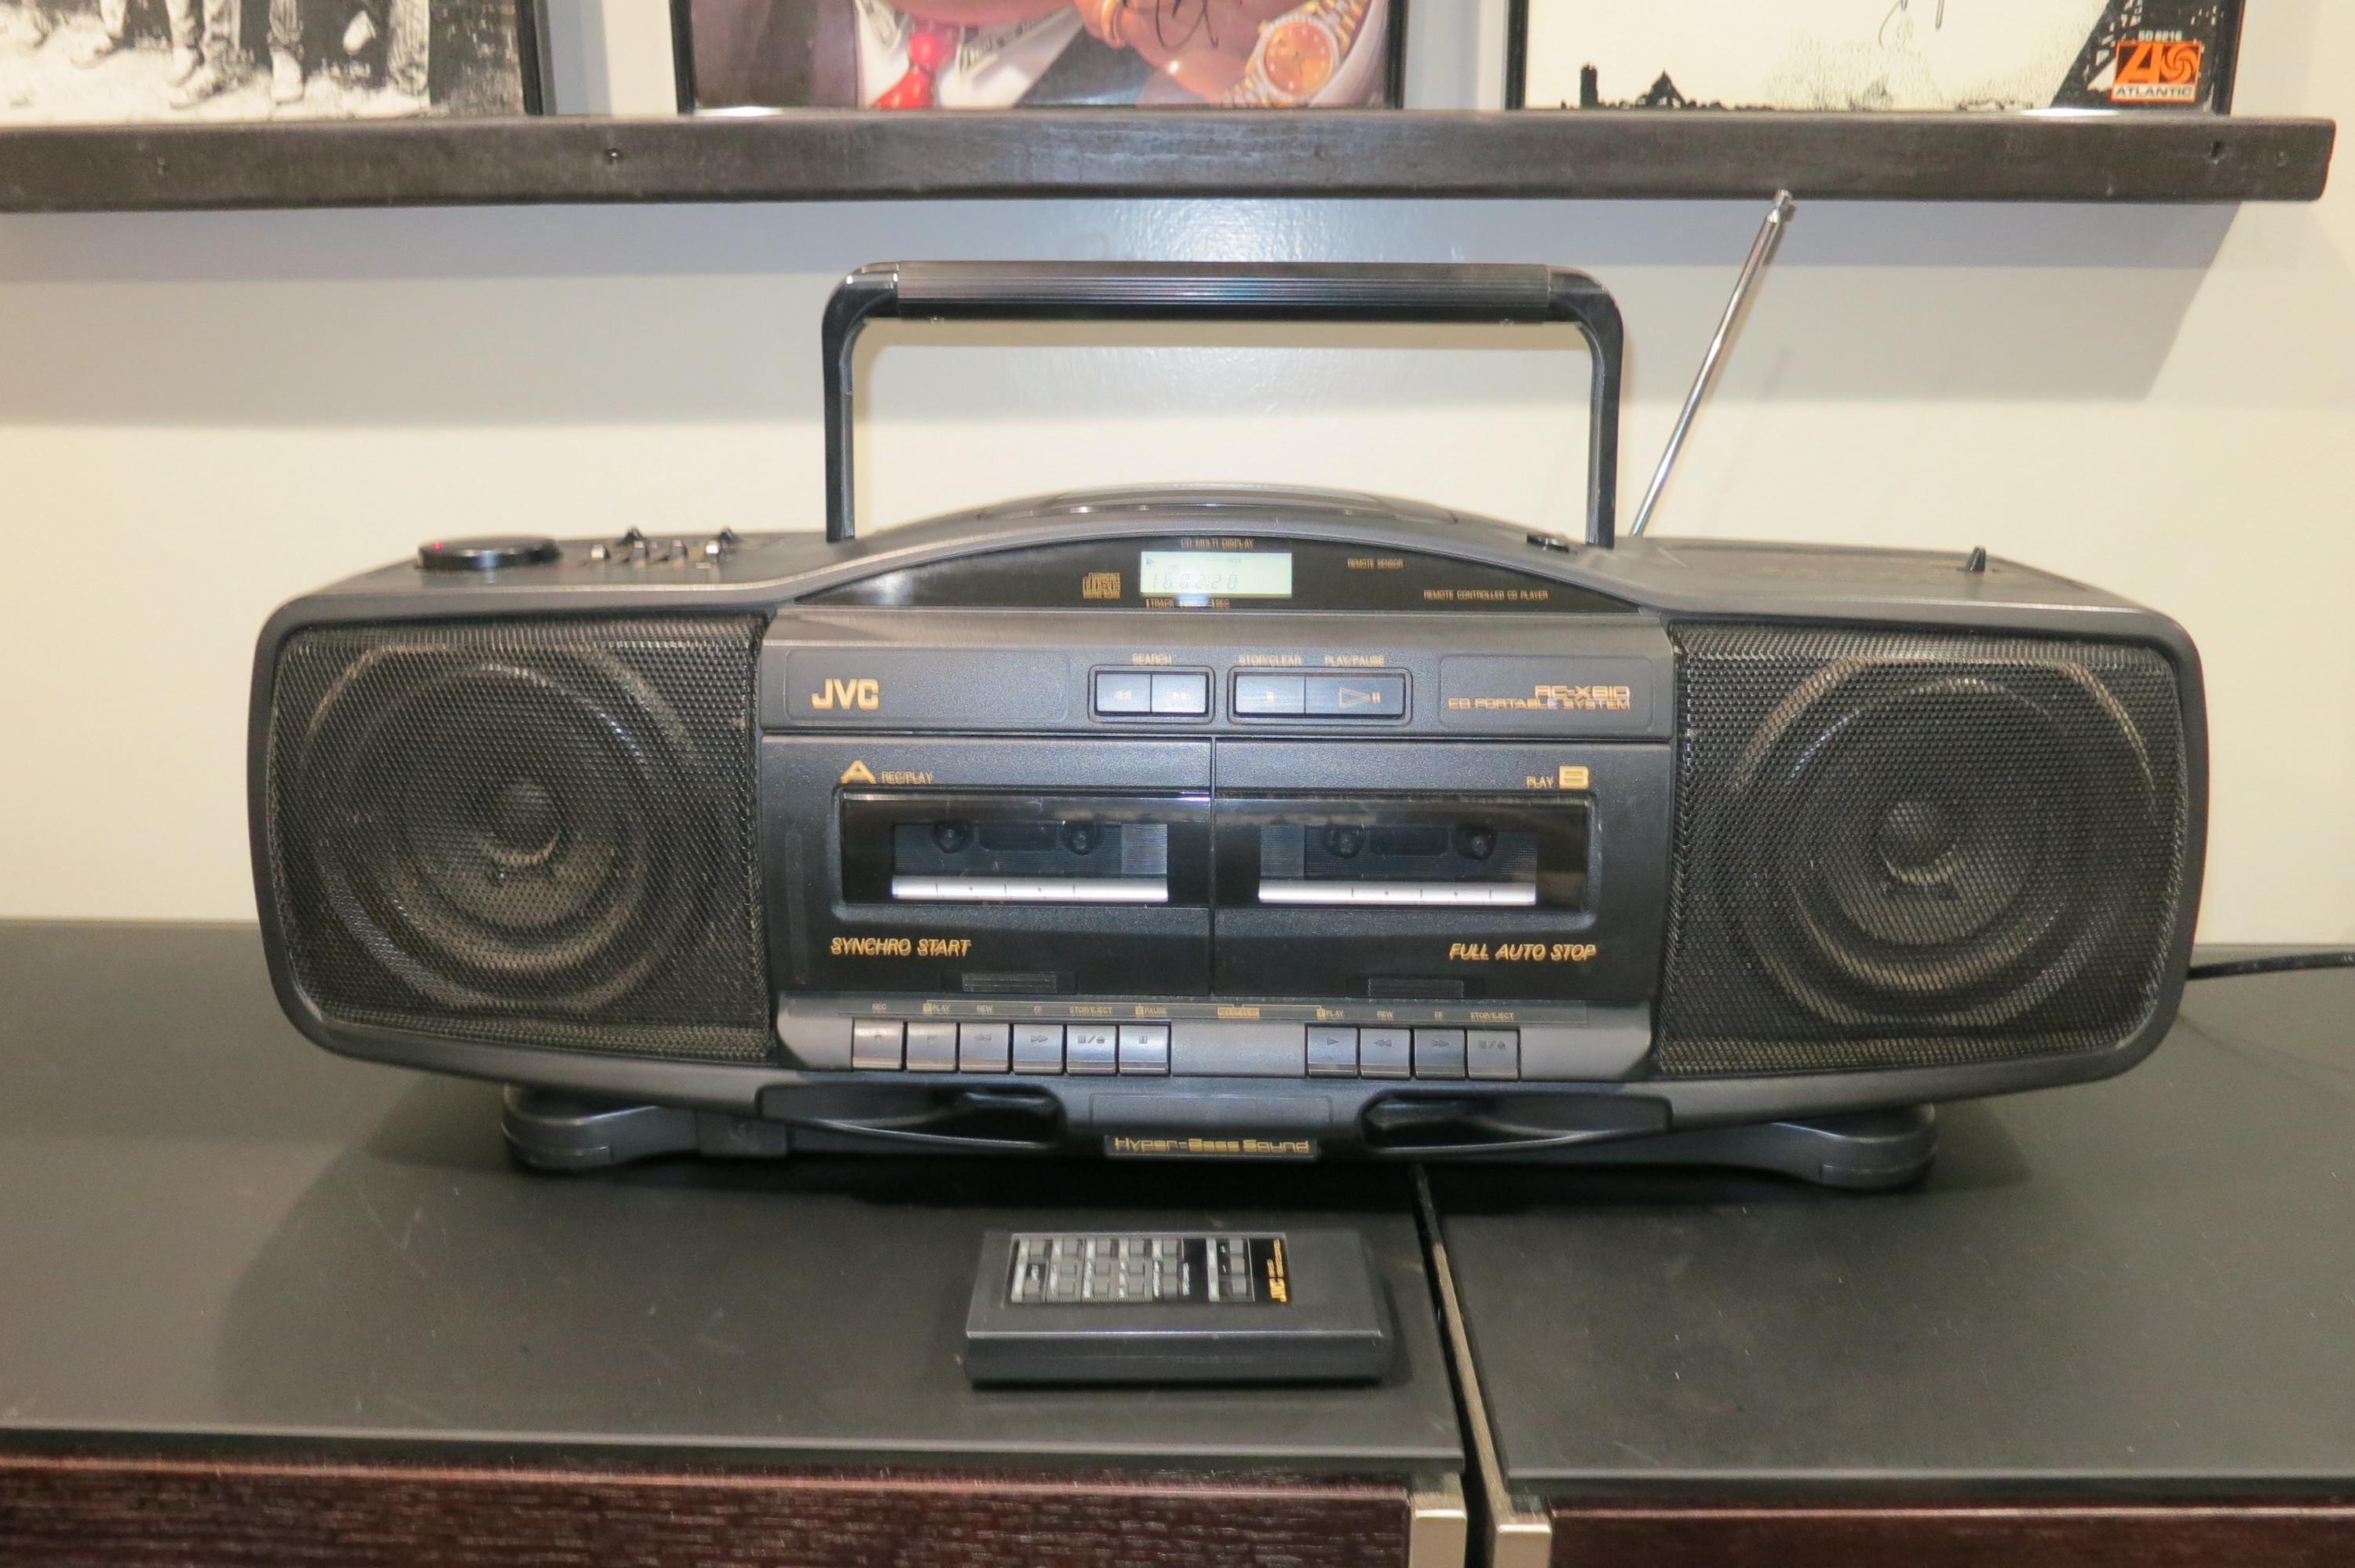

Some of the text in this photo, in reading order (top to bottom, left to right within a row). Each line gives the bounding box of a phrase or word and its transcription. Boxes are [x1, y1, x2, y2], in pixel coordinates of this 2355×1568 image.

[2115, 86, 2193, 97] ATLANTIC
[1347, 558, 1374, 569] REMOTE
[1423, 590, 1549, 600] REMOTE CONTROLLED CD PLAYER
[1132, 653, 1172, 665] SEARCH
[812, 678, 879, 709] JVC
[1448, 698, 1630, 710] CD PORTABLE SYSTEM
[841, 760, 877, 784] A
[1526, 766, 1589, 789] PLAY B
[831, 937, 972, 957] SYNCHRO START
[1449, 943, 1597, 961] FULL AUTO STOP
[872, 1004, 887, 1013] REC
[932, 1005, 950, 1014] PLAY
[977, 1005, 993, 1015] REW
[1069, 1007, 1113, 1016] STOP/EJECT
[1145, 1007, 1168, 1017] PAUSE
[1326, 1009, 1344, 1019] PLAY
[1377, 1010, 1394, 1019] REW
[1434, 1011, 1444, 1019] FF
[1470, 1012, 1513, 1021] STOP/EJECT
[1243, 1139, 1309, 1153] Sound
